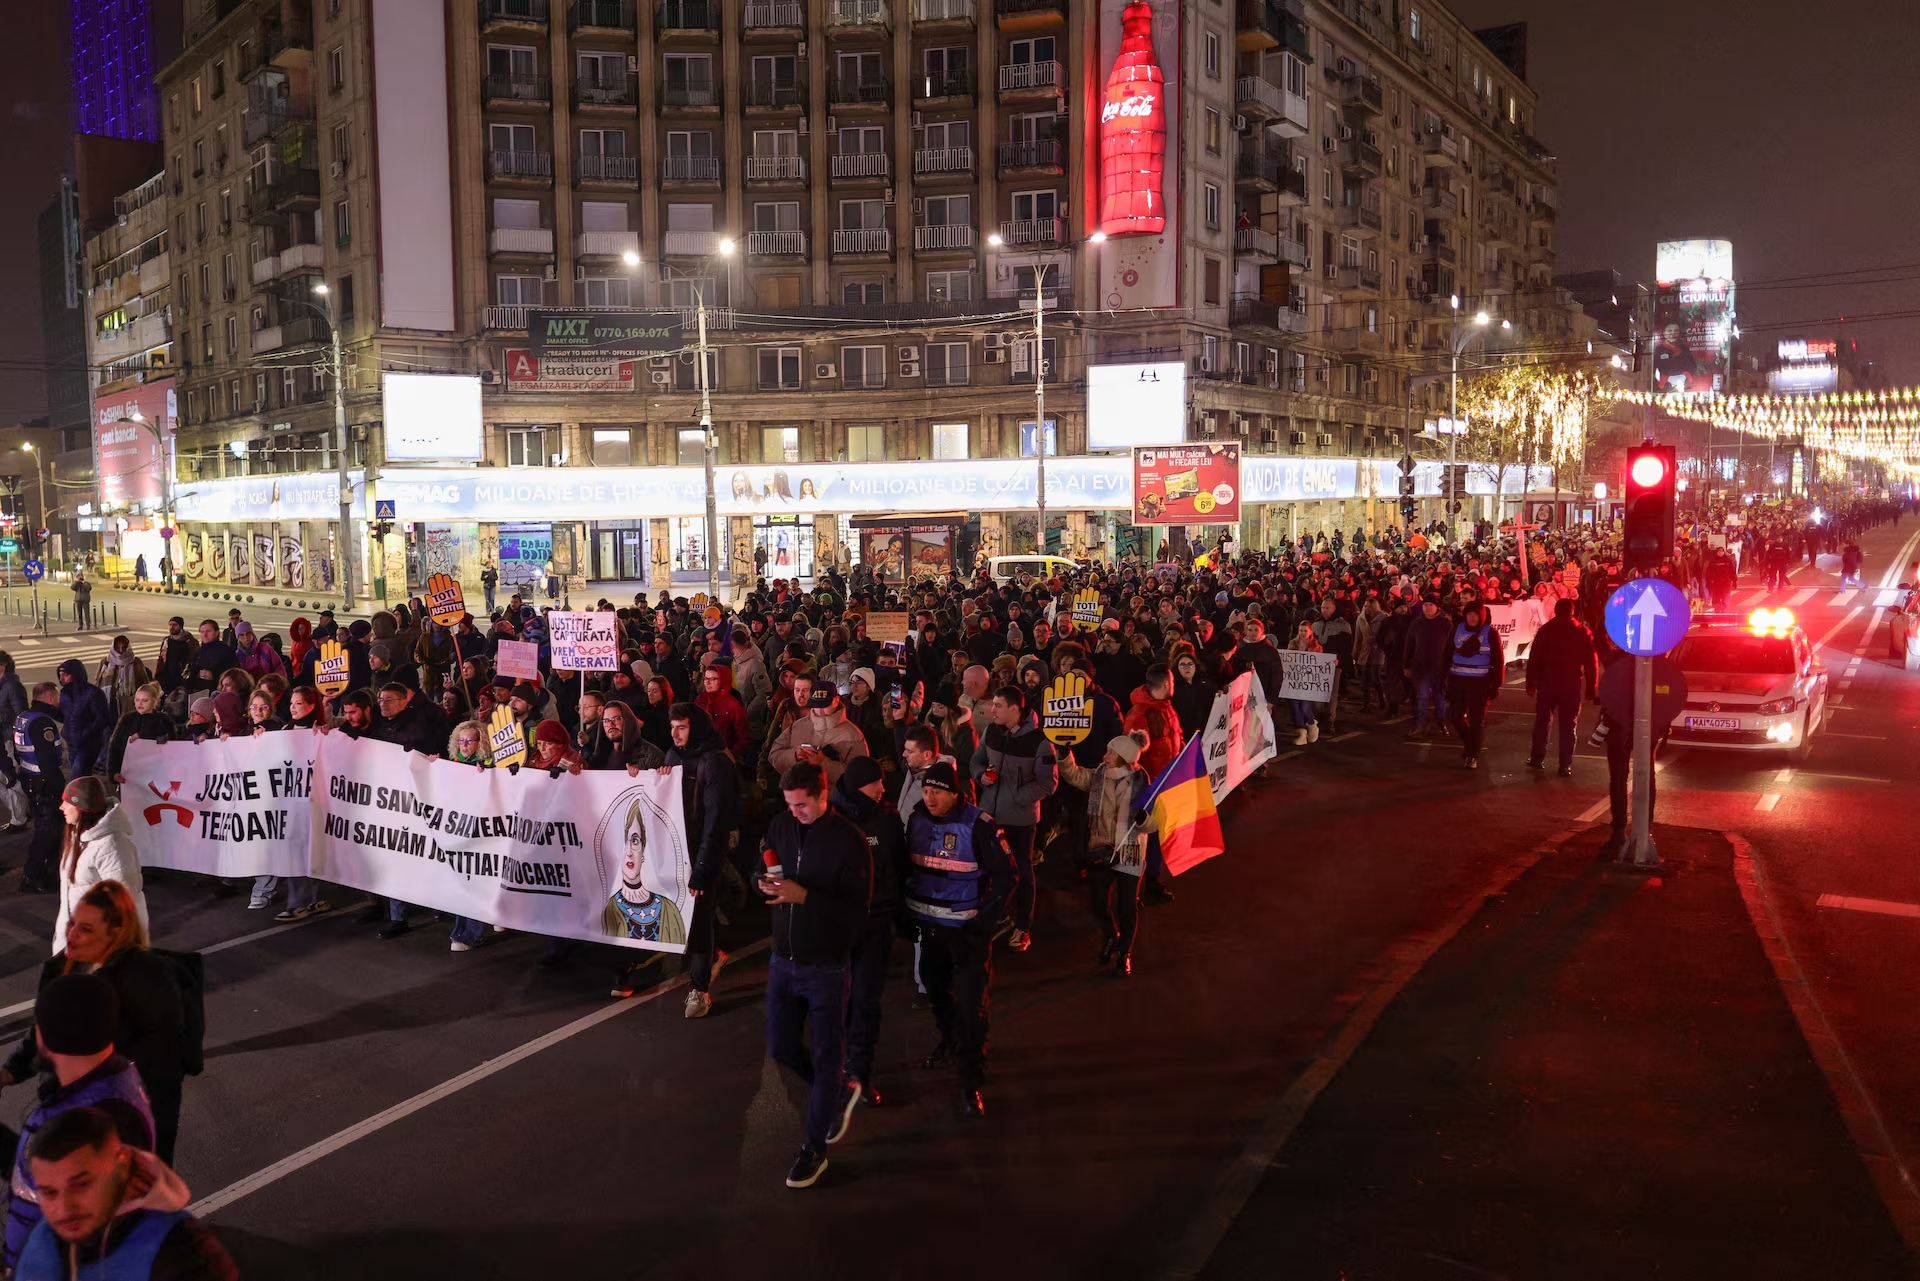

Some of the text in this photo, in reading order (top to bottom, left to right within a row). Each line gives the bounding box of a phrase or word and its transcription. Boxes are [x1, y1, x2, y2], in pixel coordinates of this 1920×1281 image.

[546, 319, 590, 336] NXT
[594, 327, 670, 338] 0770.169.074
[545, 364, 613, 376] traduceri
[584, 381, 630, 390] APOSTILE
[1157, 450, 1169, 459] MAI
[1169, 450, 1186, 459] MULT
[1175, 458, 1199, 466] FIECARE
[1200, 457, 1212, 466] LEU
[850, 478, 944, 495] MILIOANE
[950, 477, 977, 493] DE
[983, 475, 1029, 492] COZI
[1066, 474, 1087, 490] AI
[475, 485, 574, 502] MILIOANE
[579, 485, 605, 501] DE
[554, 628, 614, 642] CAPTURATĂ
[551, 646, 575, 657] VREM
[562, 654, 616, 668] ELIBERATĂ
[1289, 661, 1331, 675] VOASTRĂ
[811, 690, 828, 699] ATF
[1692, 718, 1737, 728] MAI 40753
[330, 774, 372, 806] CÂND
[324, 812, 349, 841] NOI
[353, 821, 427, 858] SALVĂM
